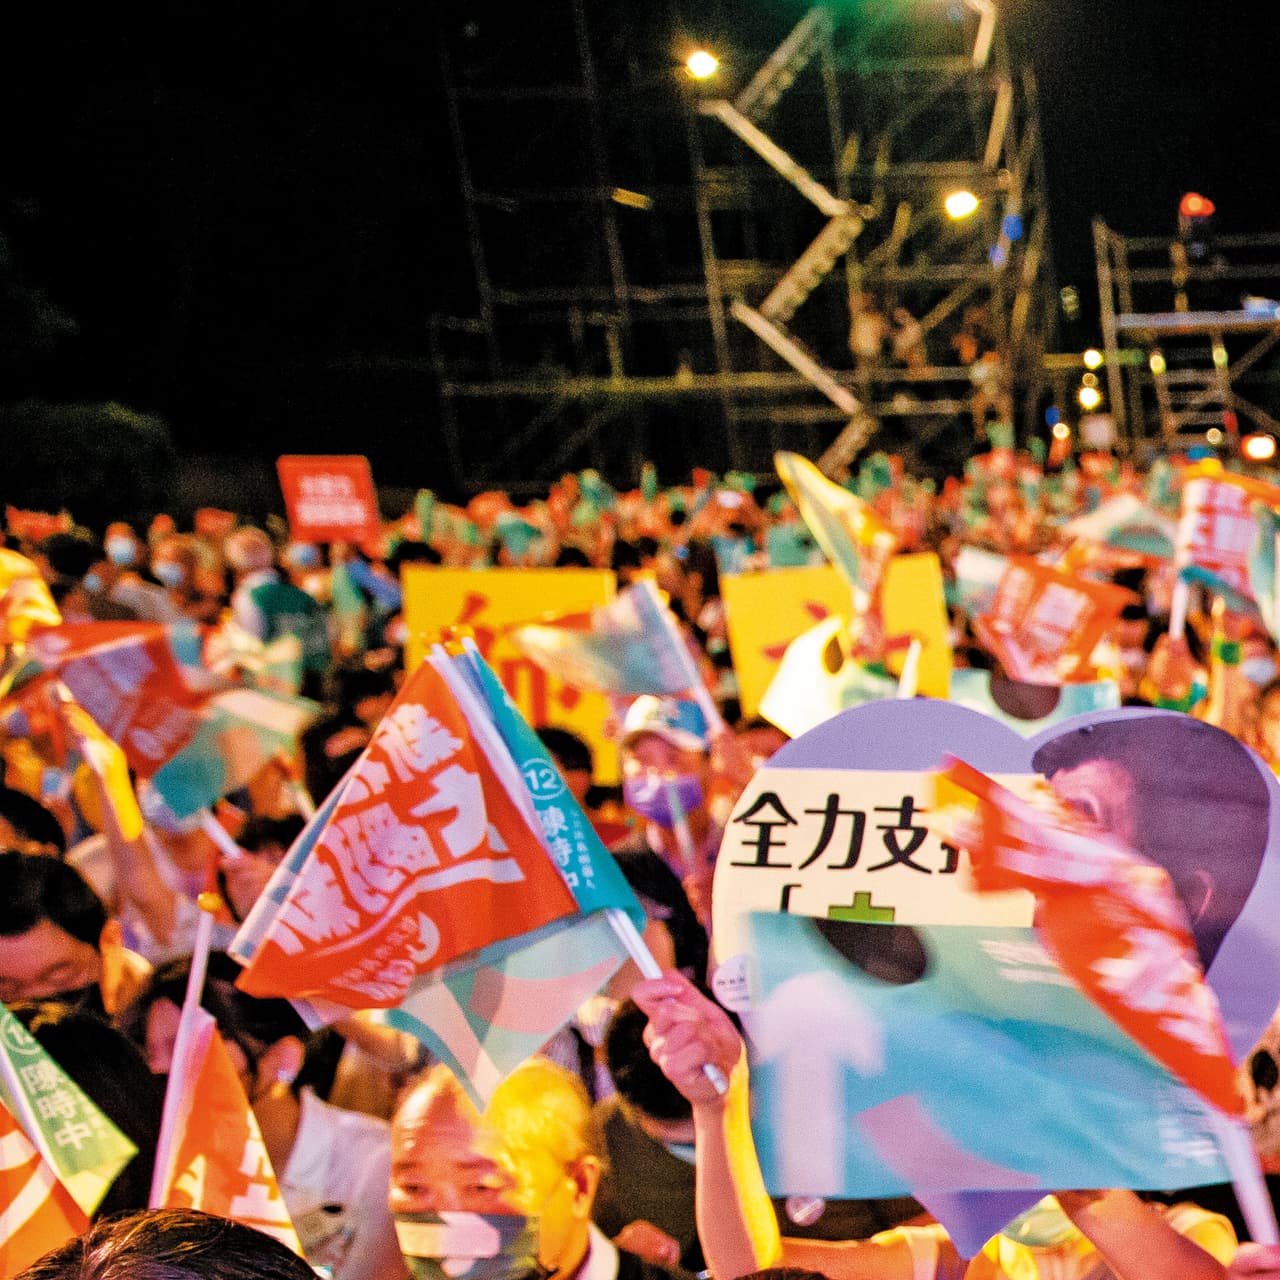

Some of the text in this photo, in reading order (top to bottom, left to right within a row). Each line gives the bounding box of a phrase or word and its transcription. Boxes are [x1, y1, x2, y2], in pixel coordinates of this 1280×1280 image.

[526, 767, 558, 791] 12
[729, 791, 960, 875] 全力支
